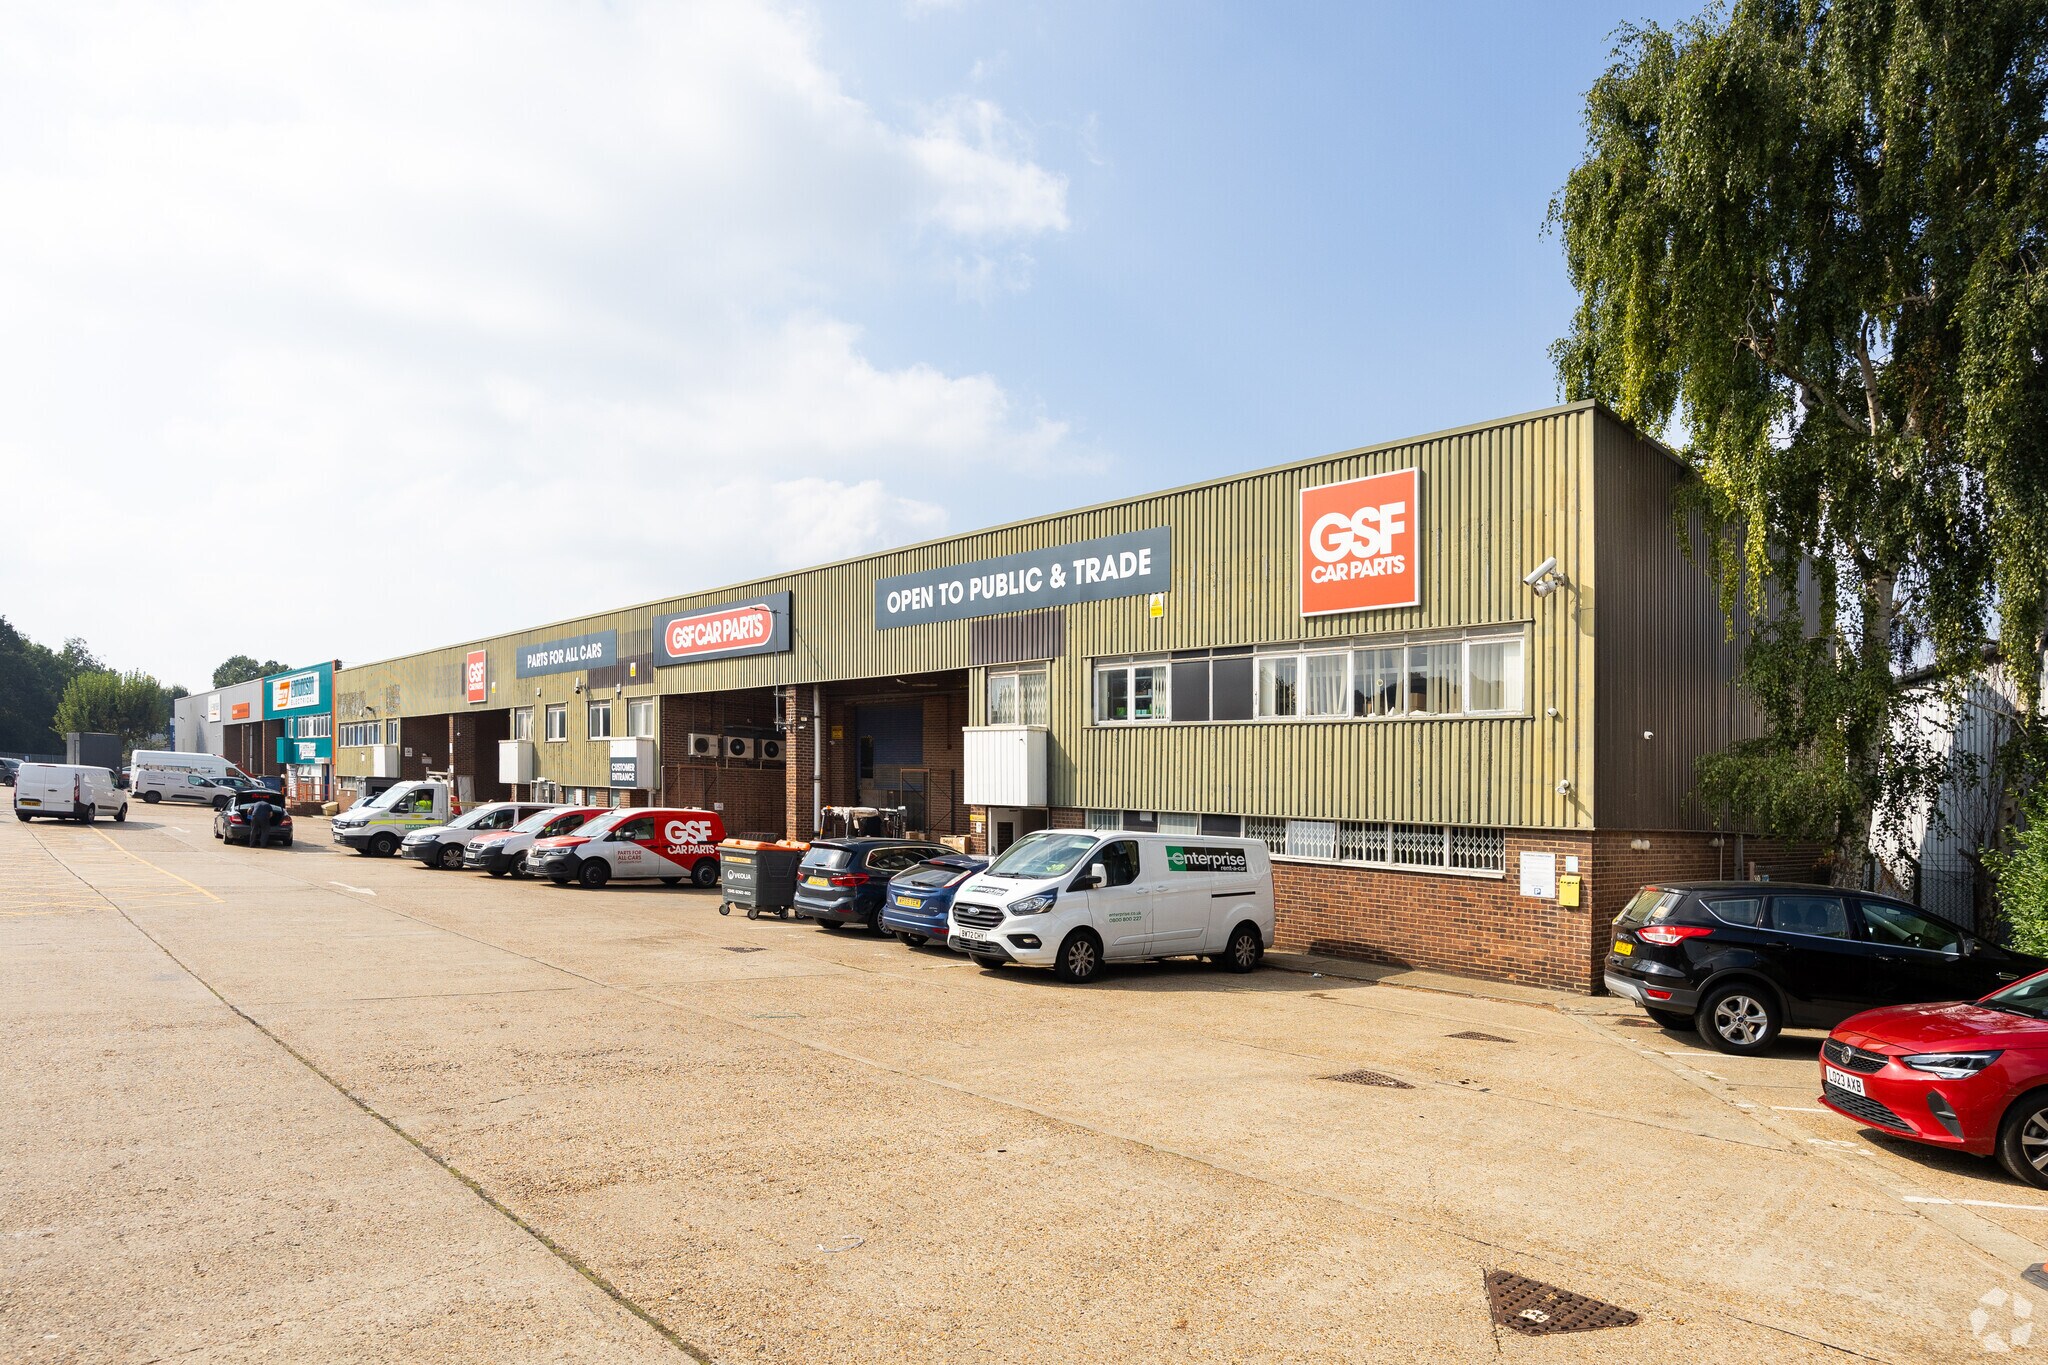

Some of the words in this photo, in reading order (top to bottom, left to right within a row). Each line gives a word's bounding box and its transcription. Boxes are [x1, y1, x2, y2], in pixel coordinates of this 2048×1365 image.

[1309, 501, 1405, 563] GSF
[887, 585, 933, 613] OPEN
[939, 581, 963, 605] TO
[970, 567, 1042, 601] PUBLIC
[1050, 563, 1066, 589] &
[1073, 548, 1151, 585] TRADE
[1311, 564, 1348, 583] CAR
[1350, 555, 1405, 579] PARTS
[672, 625, 695, 649] GSF
[695, 620, 722, 646] CAR
[723, 613, 763, 642] PARTS
[527, 652, 548, 668] PARTS
[549, 649, 564, 665] FOR
[565, 646, 578, 662] ALL
[580, 642, 602, 660] CARS
[469, 662, 483, 683] GSF
[611, 763, 635, 772] CUSTOMER
[611, 773, 635, 781] ENTRANCE
[665, 820, 712, 845] GSF
[668, 845, 687, 854] CAR
[688, 844, 715, 854] PARTS
[1171, 852, 1246, 869] enterprise
[1847, 1077, 1861, 1092] AXB
